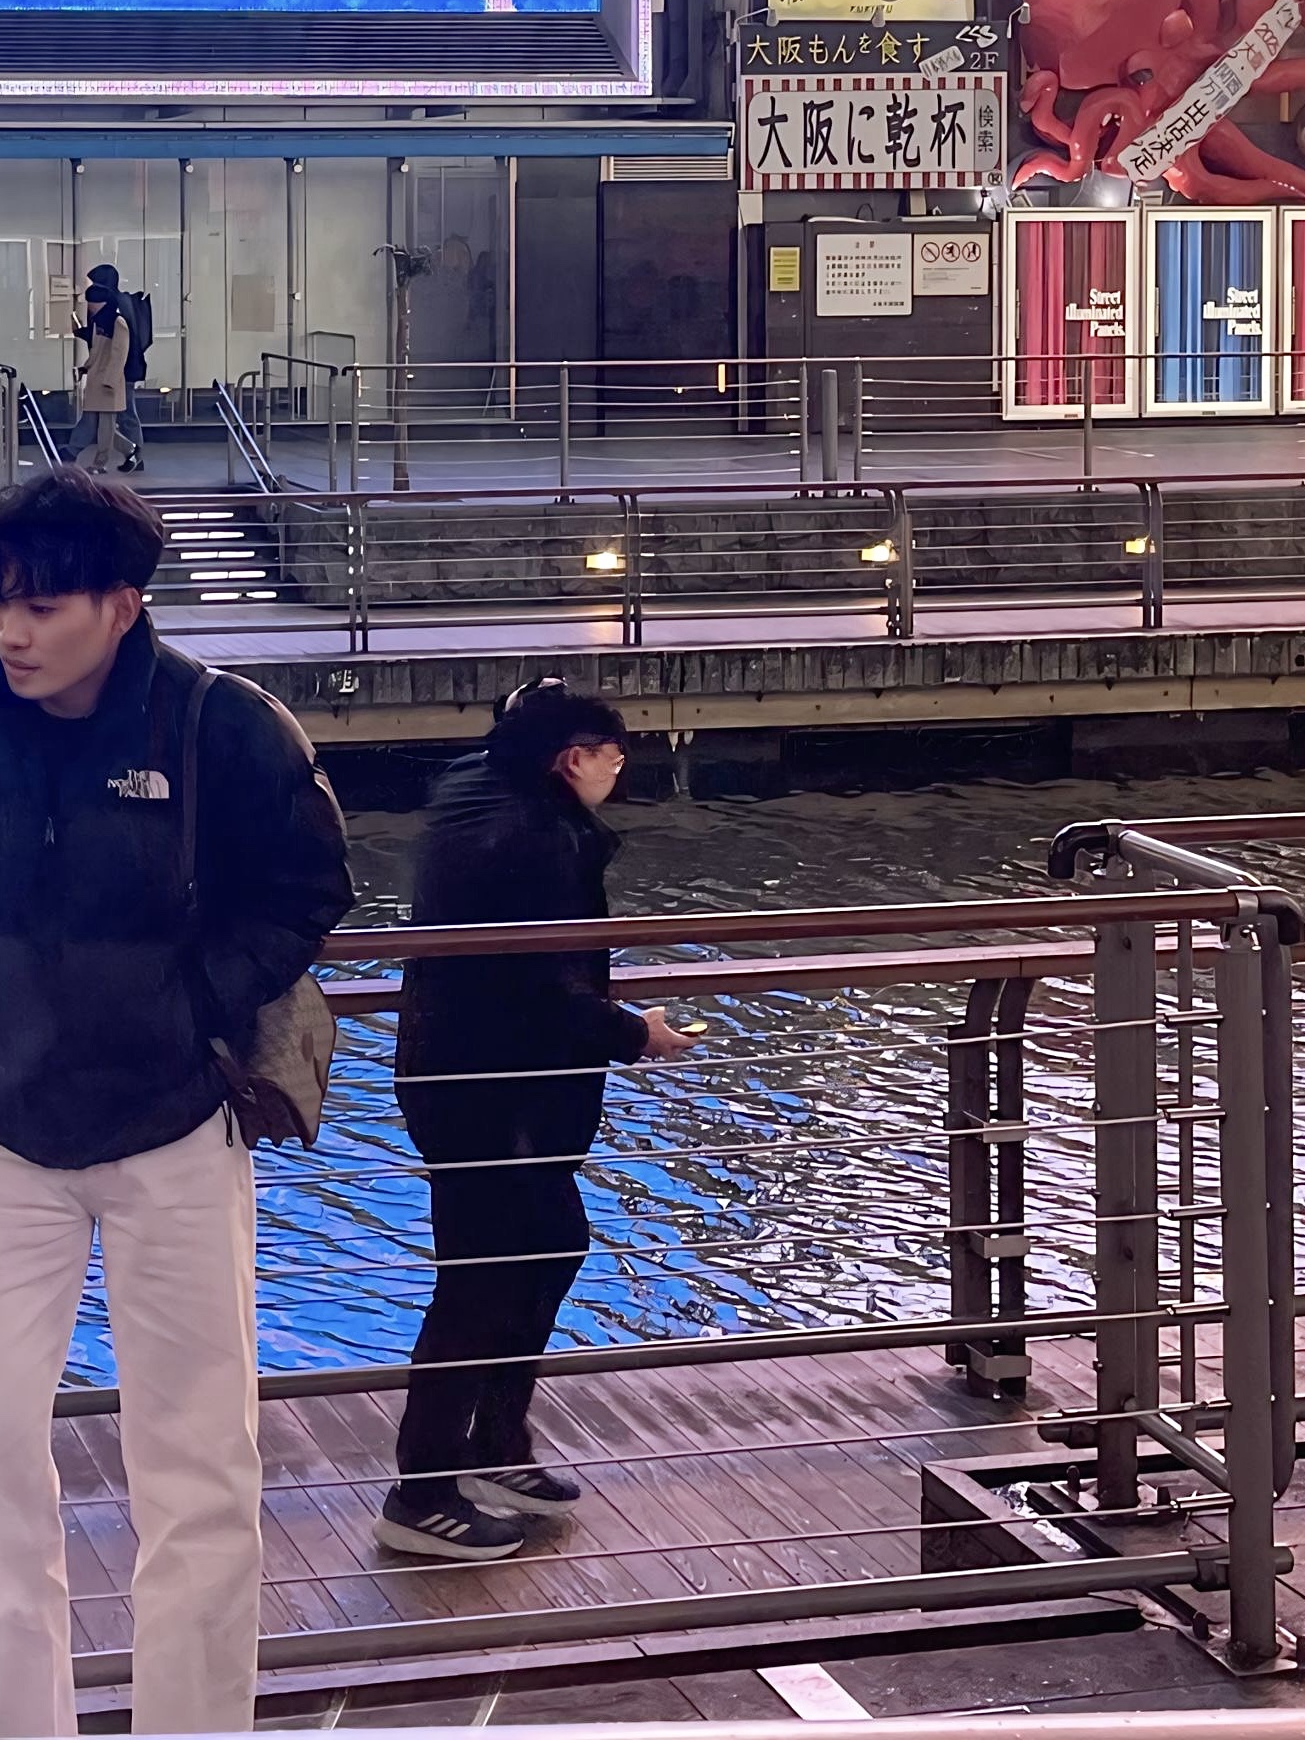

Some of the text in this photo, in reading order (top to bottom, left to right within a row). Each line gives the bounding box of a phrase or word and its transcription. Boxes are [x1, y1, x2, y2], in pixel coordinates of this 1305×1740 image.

[747, 30, 930, 66] 大阪もんを食す
[970, 52, 999, 70] 2F
[757, 92, 967, 170] 大阪に乾杯
